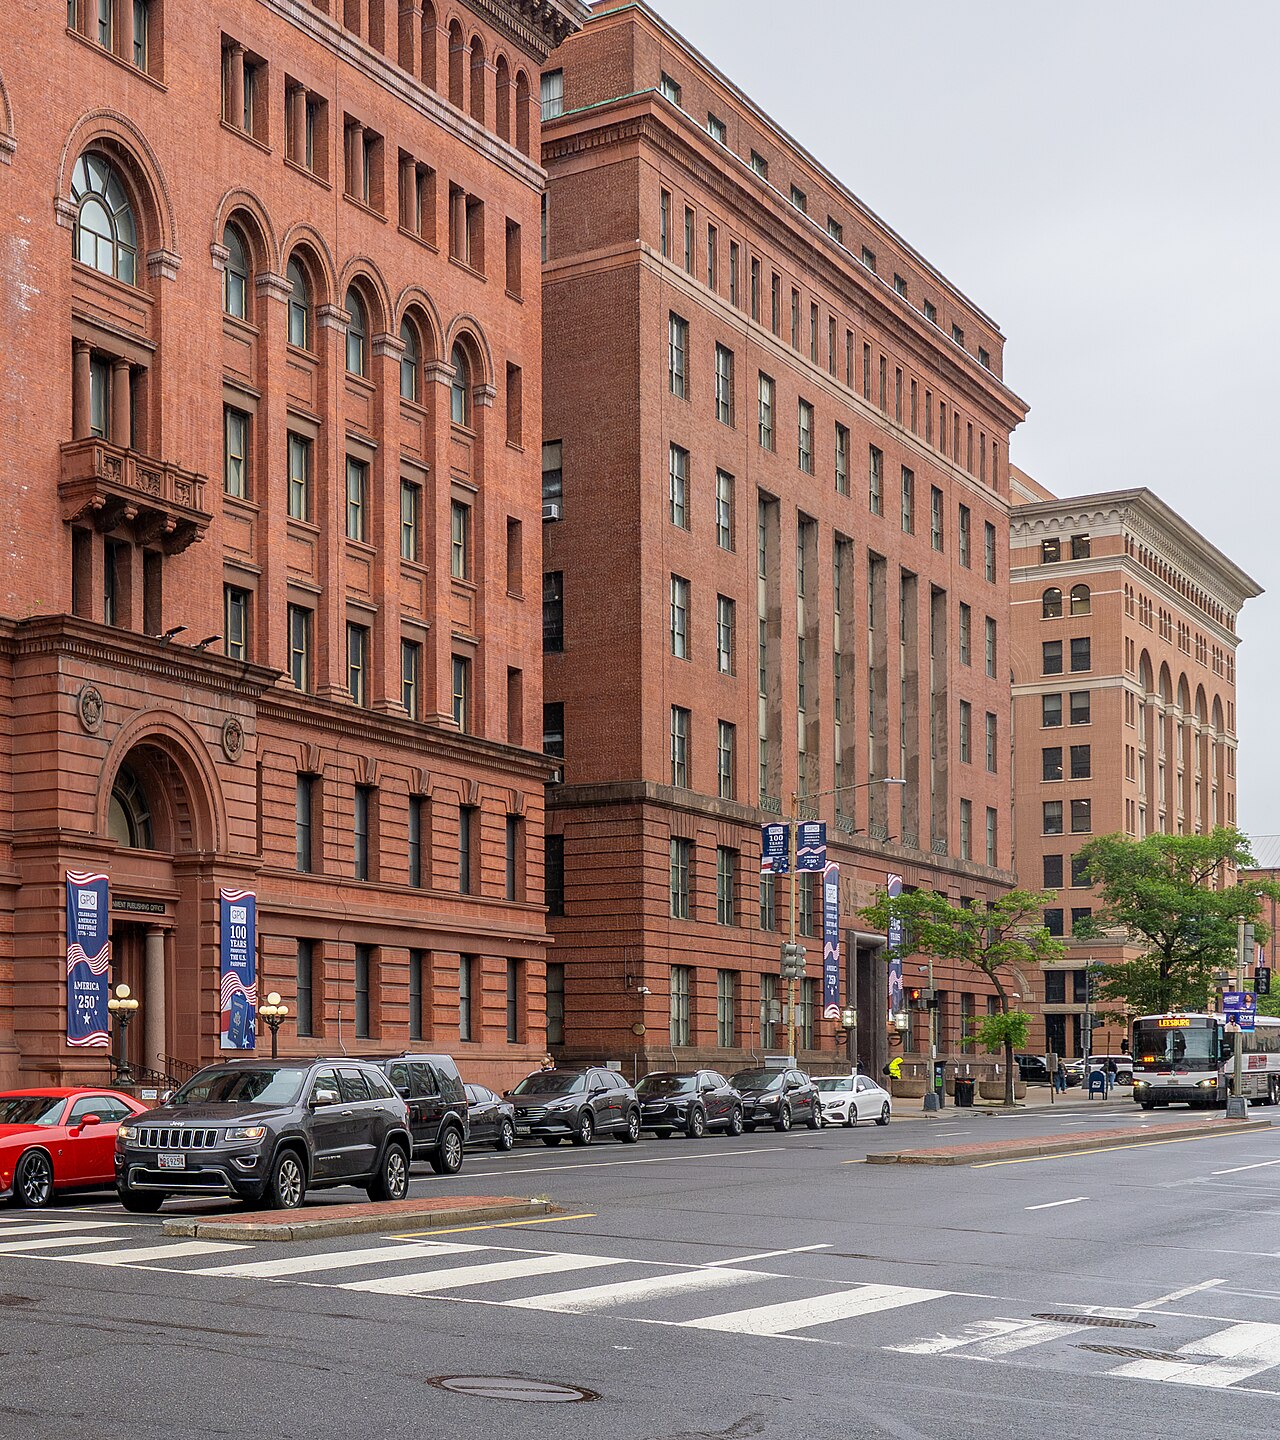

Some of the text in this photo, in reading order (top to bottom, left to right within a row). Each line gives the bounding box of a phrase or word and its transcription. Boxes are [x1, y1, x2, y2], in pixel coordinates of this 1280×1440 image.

[80, 894, 95, 905] GPO
[127, 902, 149, 910] PUBLISHING
[232, 910, 245, 920] GPO
[230, 925, 246, 939] 100
[230, 940, 246, 948] YEARS
[74, 981, 99, 991] AMERICA
[78, 995, 94, 1008] 250
[1159, 1019, 1190, 1027] LEESBURG
